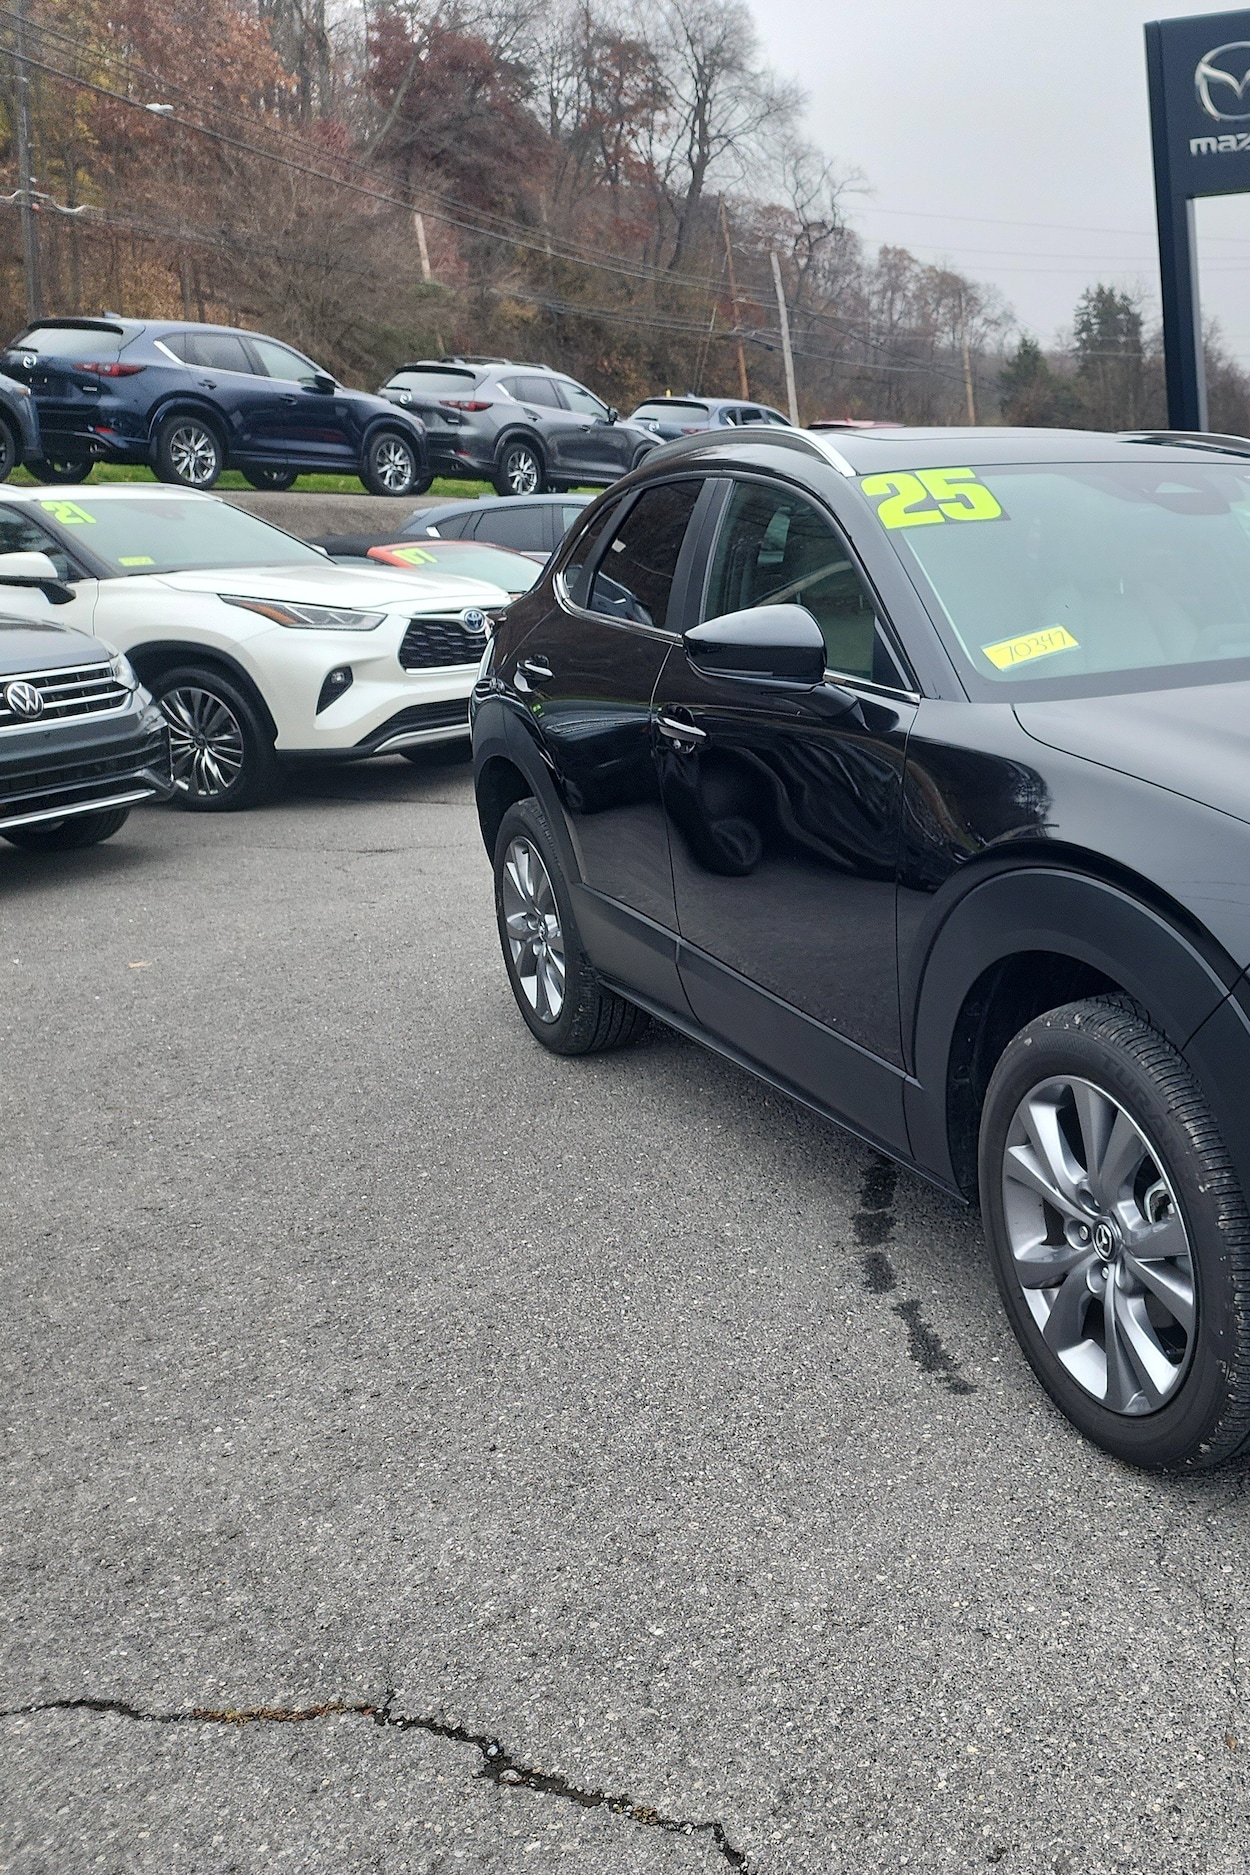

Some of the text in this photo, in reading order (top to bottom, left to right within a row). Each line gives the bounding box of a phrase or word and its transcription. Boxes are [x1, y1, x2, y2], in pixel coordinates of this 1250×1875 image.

[861, 467, 1003, 530] 25
[41, 501, 97, 525] 21
[391, 547, 438, 565] 07
[995, 630, 1067, 662] 70347
